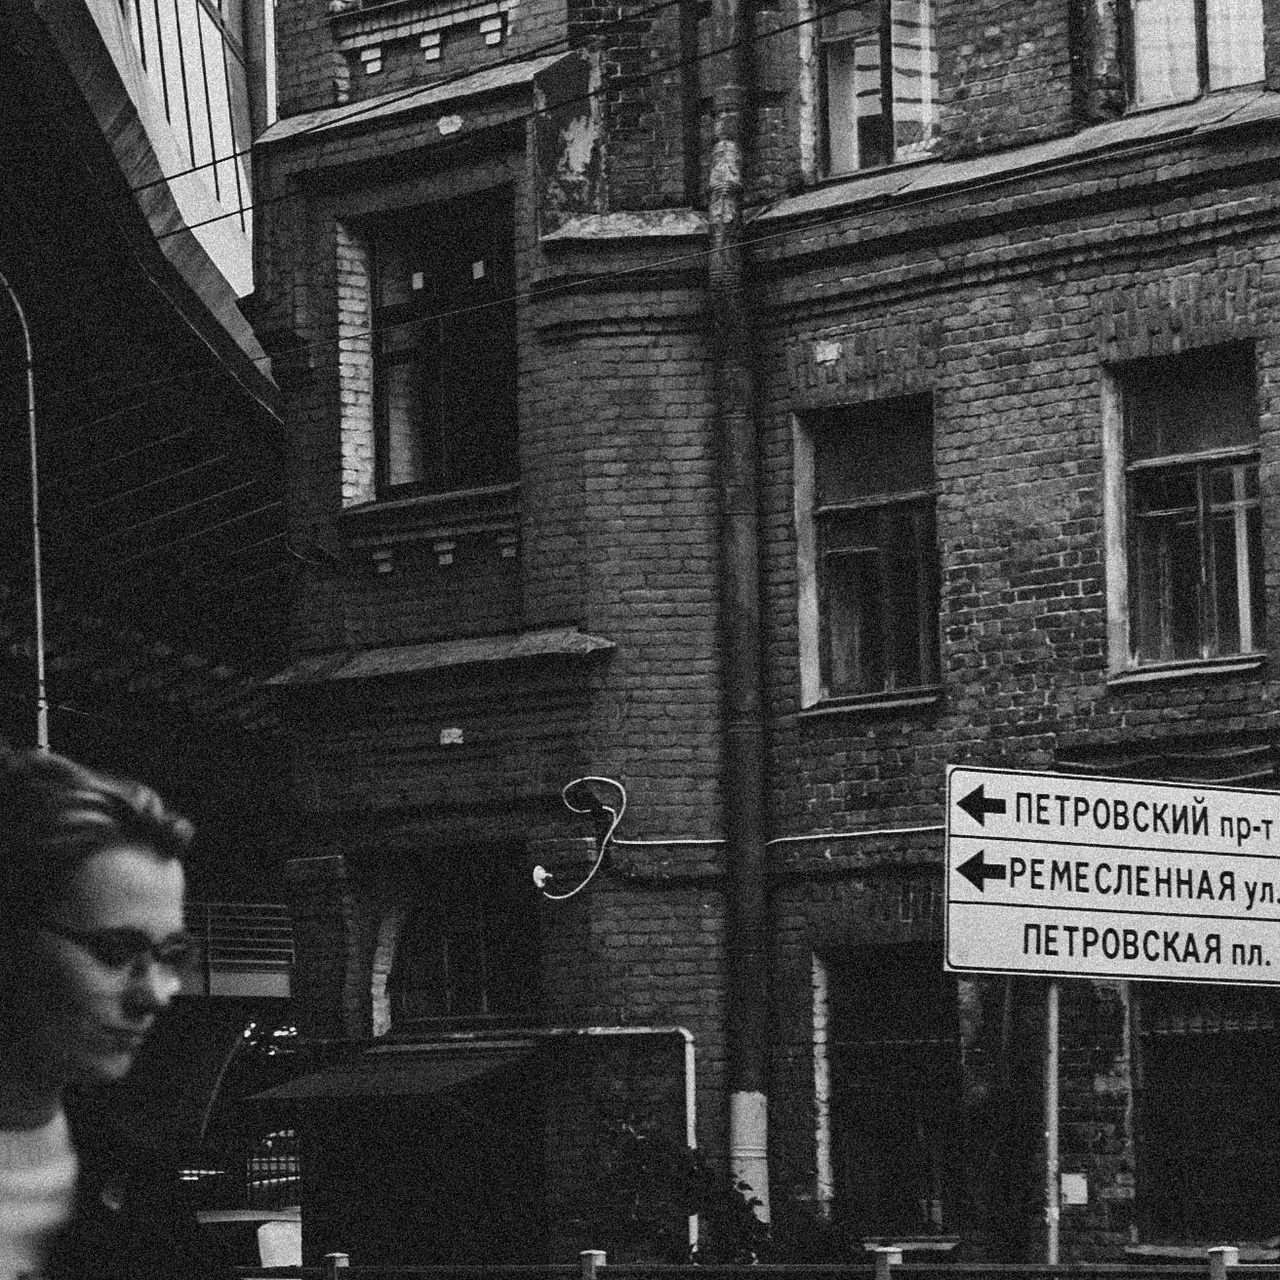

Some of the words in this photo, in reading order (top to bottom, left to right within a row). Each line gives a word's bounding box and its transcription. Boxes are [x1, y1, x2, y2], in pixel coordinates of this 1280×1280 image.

[1016, 792, 1209, 836] ПЕТРОВСКИЙ
[1220, 816, 1273, 847] пр-т
[1010, 857, 1235, 901] РЕМЕСЛЕННАЯ
[1244, 881, 1280, 911] ул.
[1023, 923, 1221, 964] ПЕТРОВСКАЯ
[1232, 944, 1271, 966] пл.
